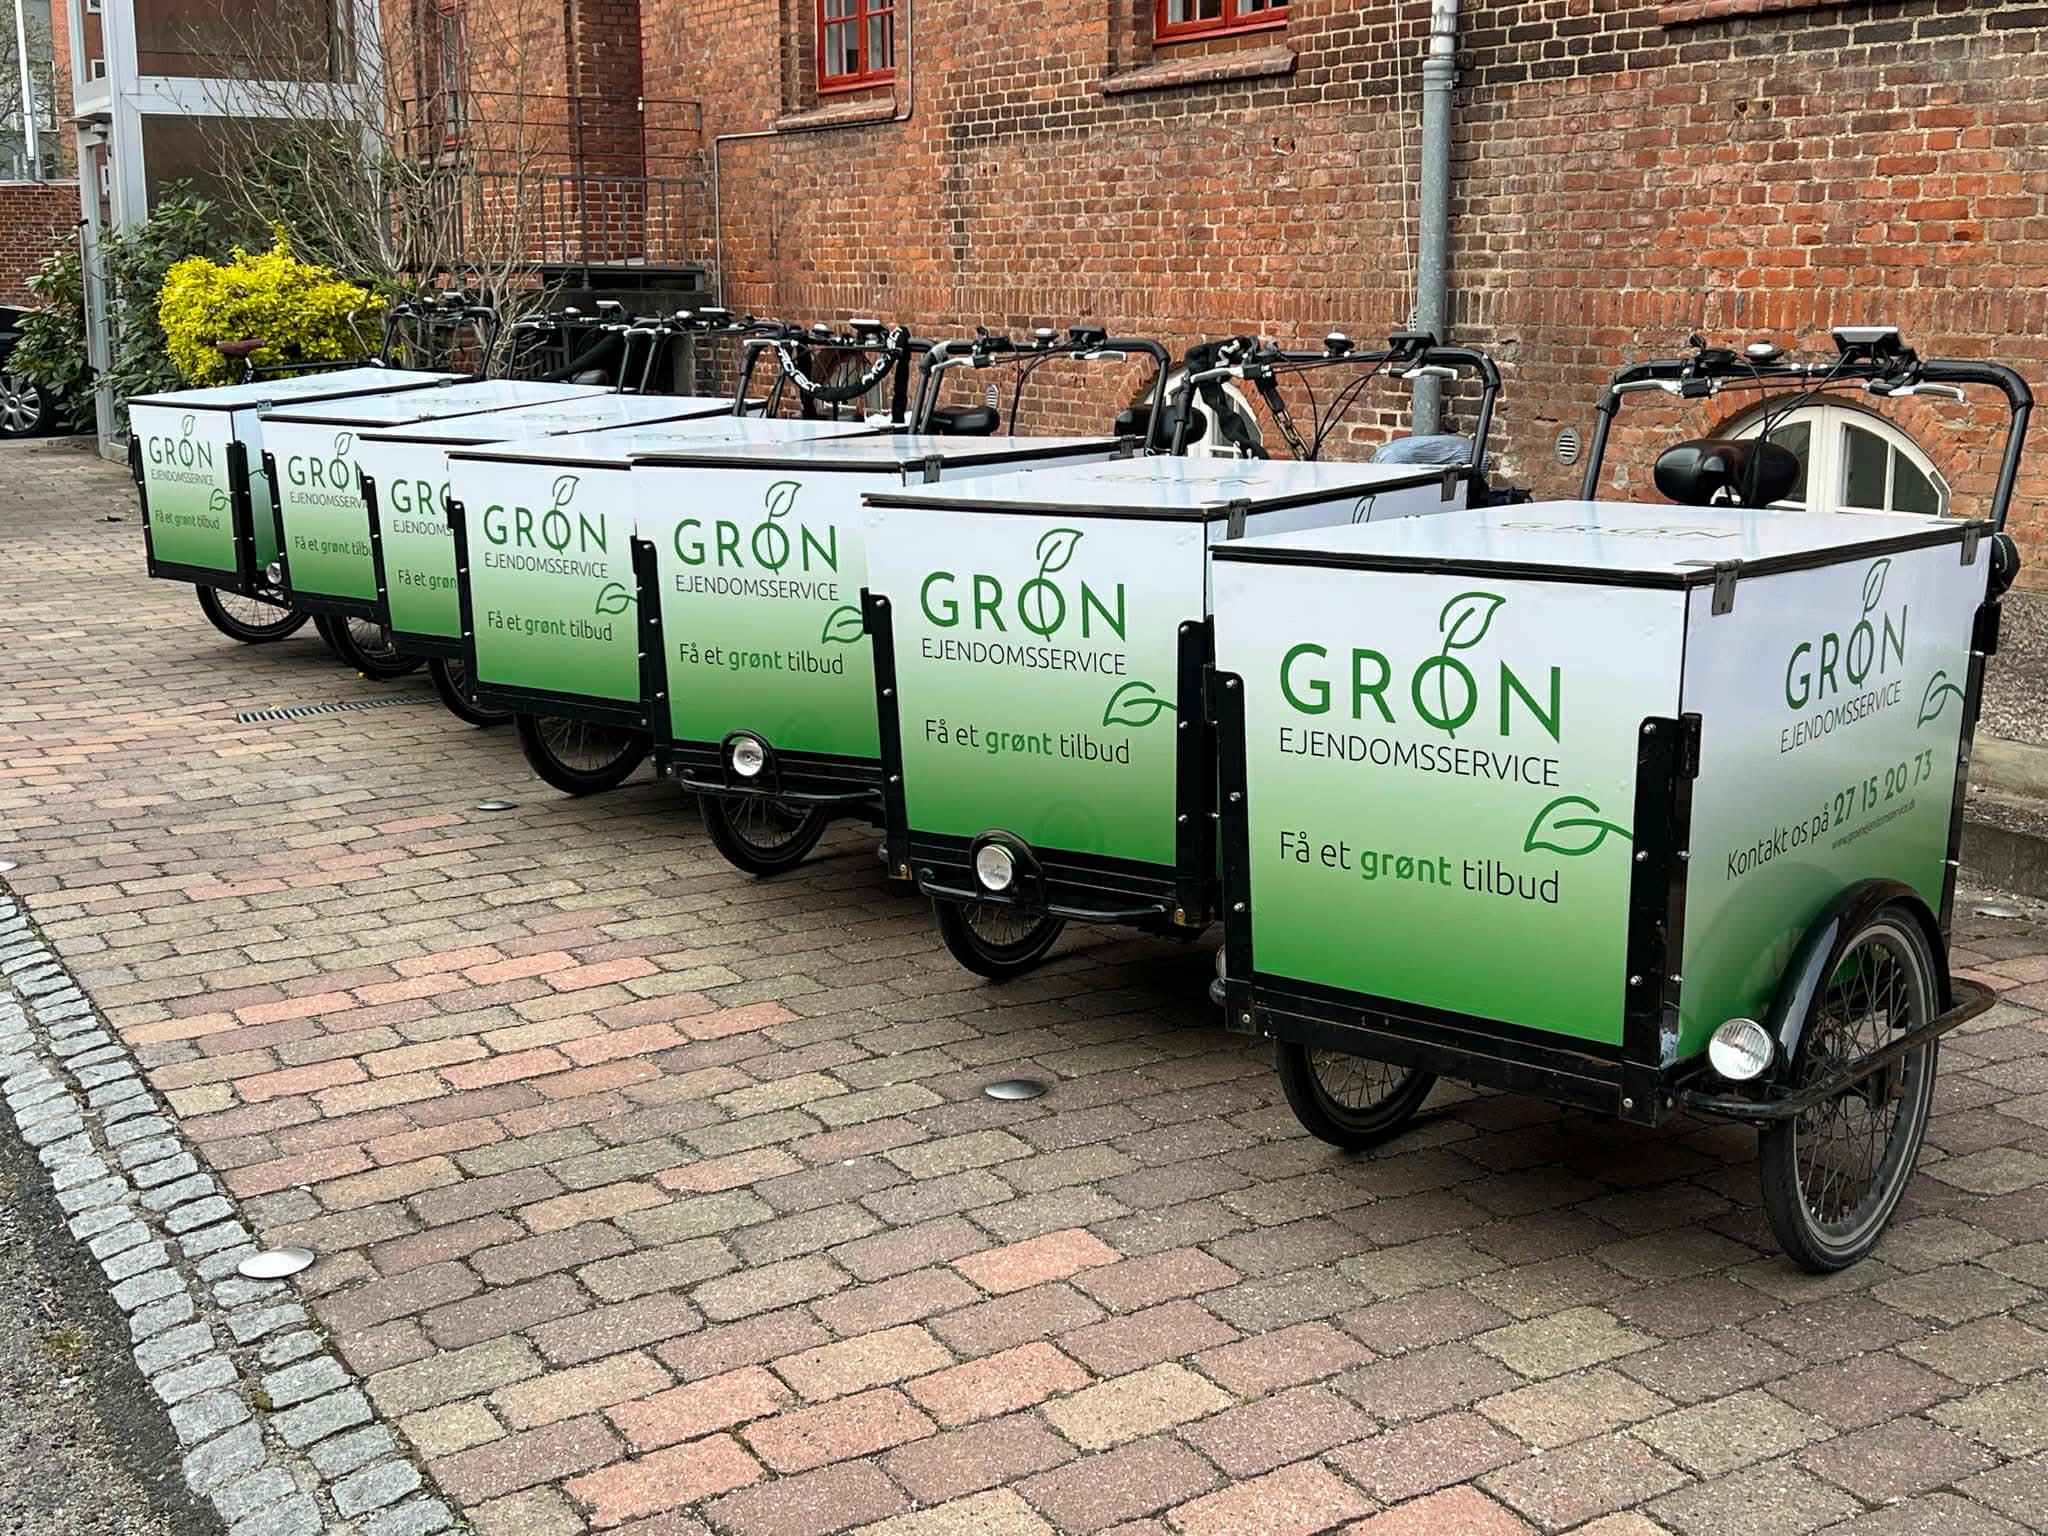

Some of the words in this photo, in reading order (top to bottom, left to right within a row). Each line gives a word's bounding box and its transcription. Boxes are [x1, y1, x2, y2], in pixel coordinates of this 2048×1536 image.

[149, 436, 213, 469] GRØN
[294, 535, 306, 550] Få
[308, 538, 319, 552] et
[321, 540, 350, 555] grønt
[483, 505, 608, 554] GRØN
[674, 518, 839, 574] GRØN
[398, 568, 411, 585] Få
[414, 572, 426, 587] et
[429, 575, 457, 591] grøn
[484, 552, 608, 579] EJENDOMSSERVICE
[676, 574, 840, 601] EJENDOMSSERVICE
[487, 609, 503, 629] Få
[506, 614, 522, 632] et
[525, 618, 566, 636] grønt
[569, 619, 613, 642] tilbud
[920, 571, 1126, 642] GRØN
[679, 642, 699, 664] Få
[704, 646, 725, 666] et
[728, 650, 783, 671] grønt
[787, 650, 844, 675] tilbud
[921, 637, 1128, 676] EJENDOMSSERVICE
[1785, 604, 1908, 710] GRØN
[1279, 642, 1561, 744] GRØN
[1780, 680, 1902, 754] EJENDOMSSERVICE
[925, 718, 949, 744] Få
[956, 724, 980, 748] et
[985, 729, 1053, 755] grønt
[1059, 734, 1130, 765] tilbud
[1279, 726, 1560, 788] EJENDOMSSERVICE
[1727, 826, 1788, 881] Kontakt
[1791, 820, 1808, 848] os
[1811, 802, 1830, 845] på
[1833, 785, 1856, 827] 27
[1862, 774, 1878, 812] 15
[1885, 761, 1908, 801] 20
[1914, 748, 1933, 787] 73
[1279, 830, 1311, 864] Få
[1320, 840, 1352, 871] et
[1360, 849, 1452, 887] grønt
[1462, 859, 1560, 905] tilbud
